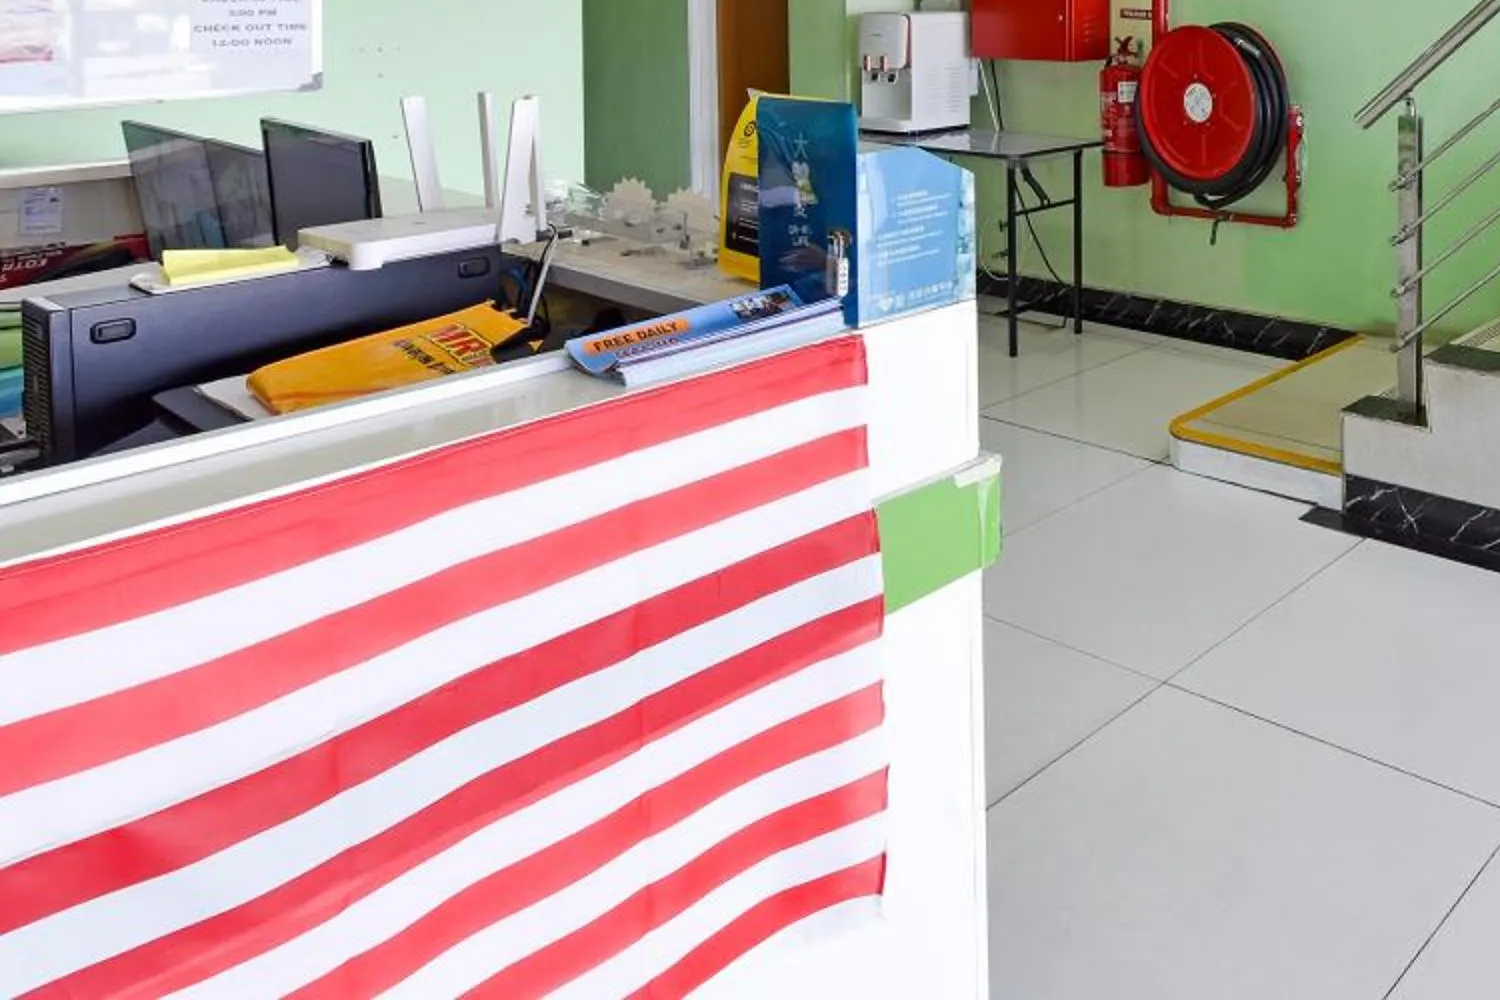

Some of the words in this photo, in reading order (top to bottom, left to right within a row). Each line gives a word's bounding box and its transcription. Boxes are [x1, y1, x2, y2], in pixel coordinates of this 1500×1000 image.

[193, 23, 240, 33] CHECK
[245, 23, 272, 33] OUT
[253, 37, 294, 47] NOON
[593, 331, 634, 352] FREE
[638, 319, 679, 340] DAILY
